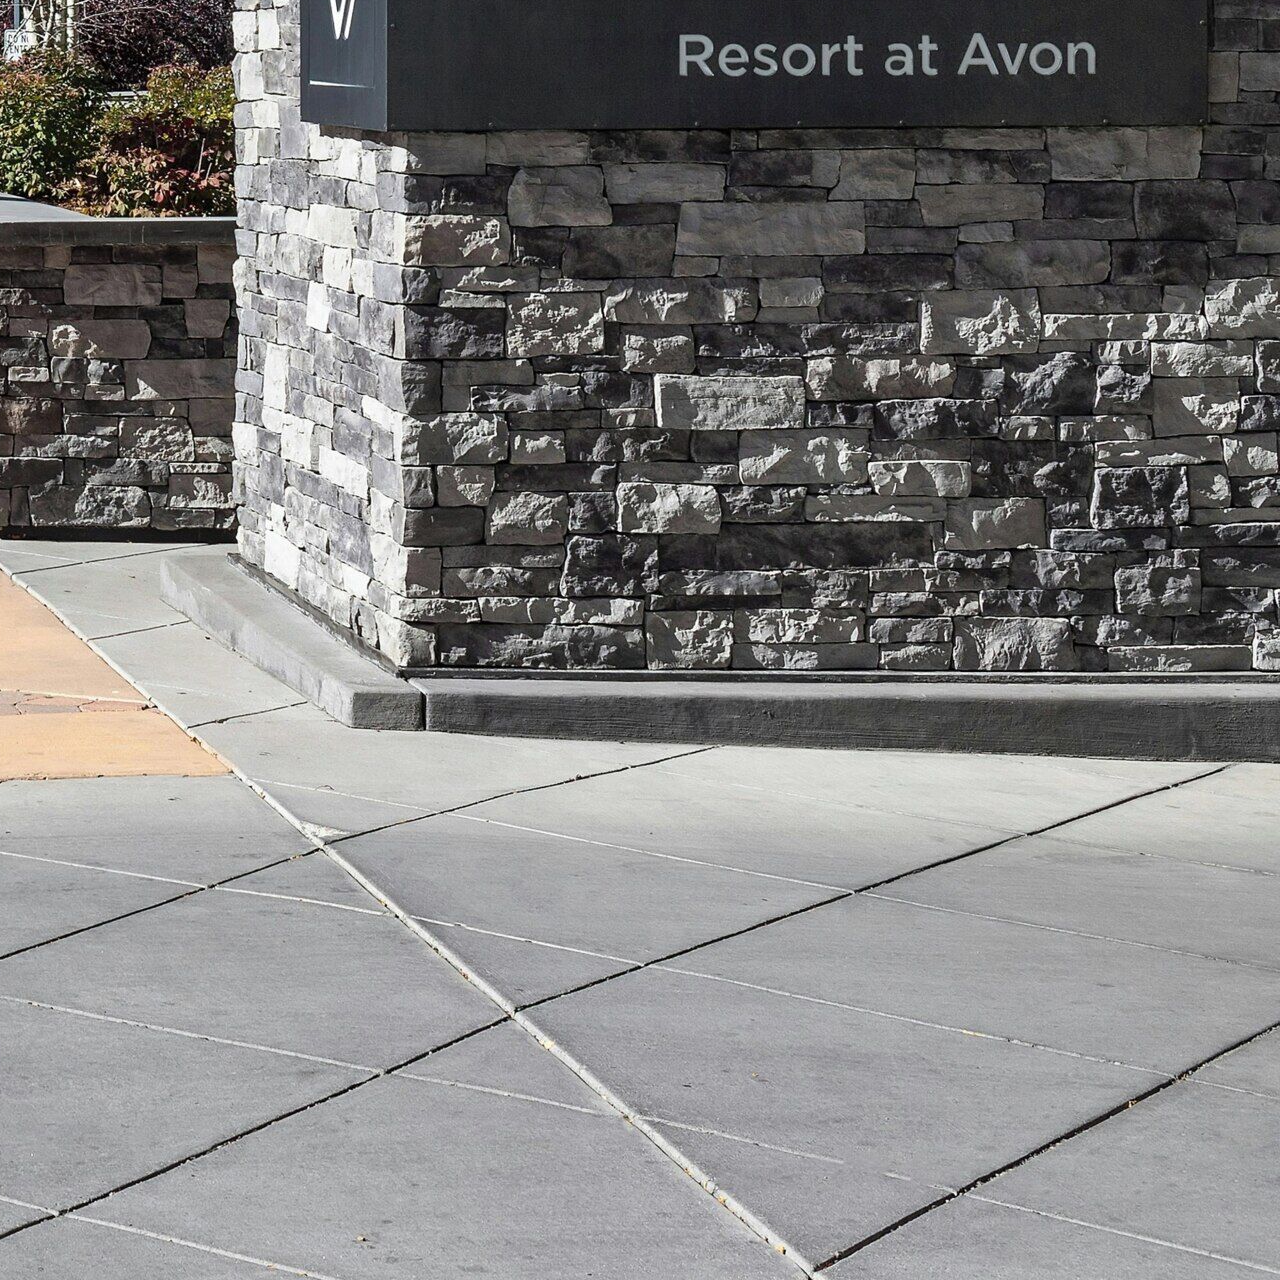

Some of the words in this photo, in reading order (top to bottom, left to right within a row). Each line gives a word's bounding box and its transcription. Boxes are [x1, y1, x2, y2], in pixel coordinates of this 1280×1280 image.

[678, 33, 864, 77] Resort
[884, 34, 938, 76] at
[957, 32, 1097, 76] Avon
